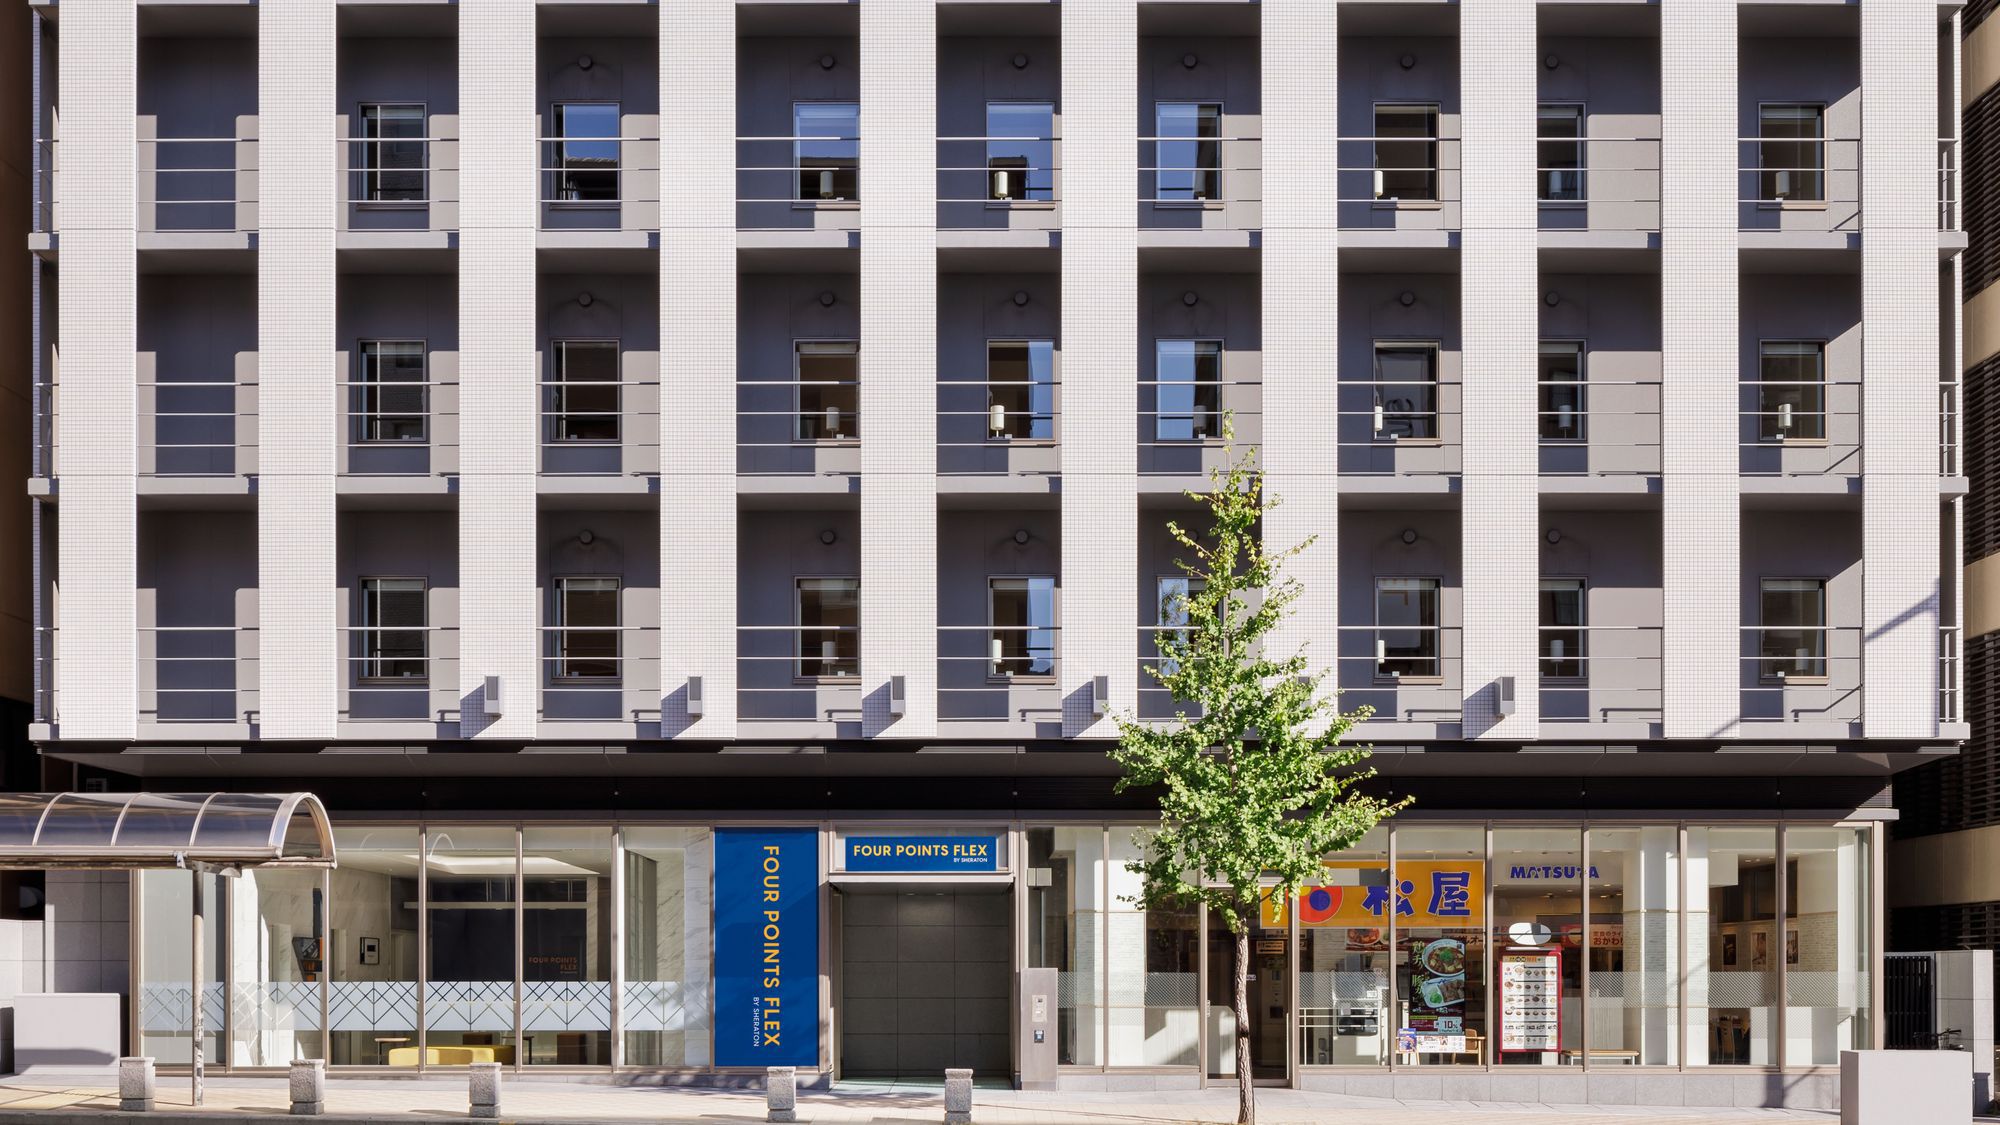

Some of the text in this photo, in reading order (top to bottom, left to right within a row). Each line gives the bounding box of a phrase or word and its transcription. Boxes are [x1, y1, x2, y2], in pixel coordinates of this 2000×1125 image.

[853, 844, 987, 856] FOUR POINTS FLEX
[1361, 871, 1472, 917] 松屋
[763, 845, 780, 1046] FOUR POINTS FLEX
[753, 997, 760, 1006] BY
